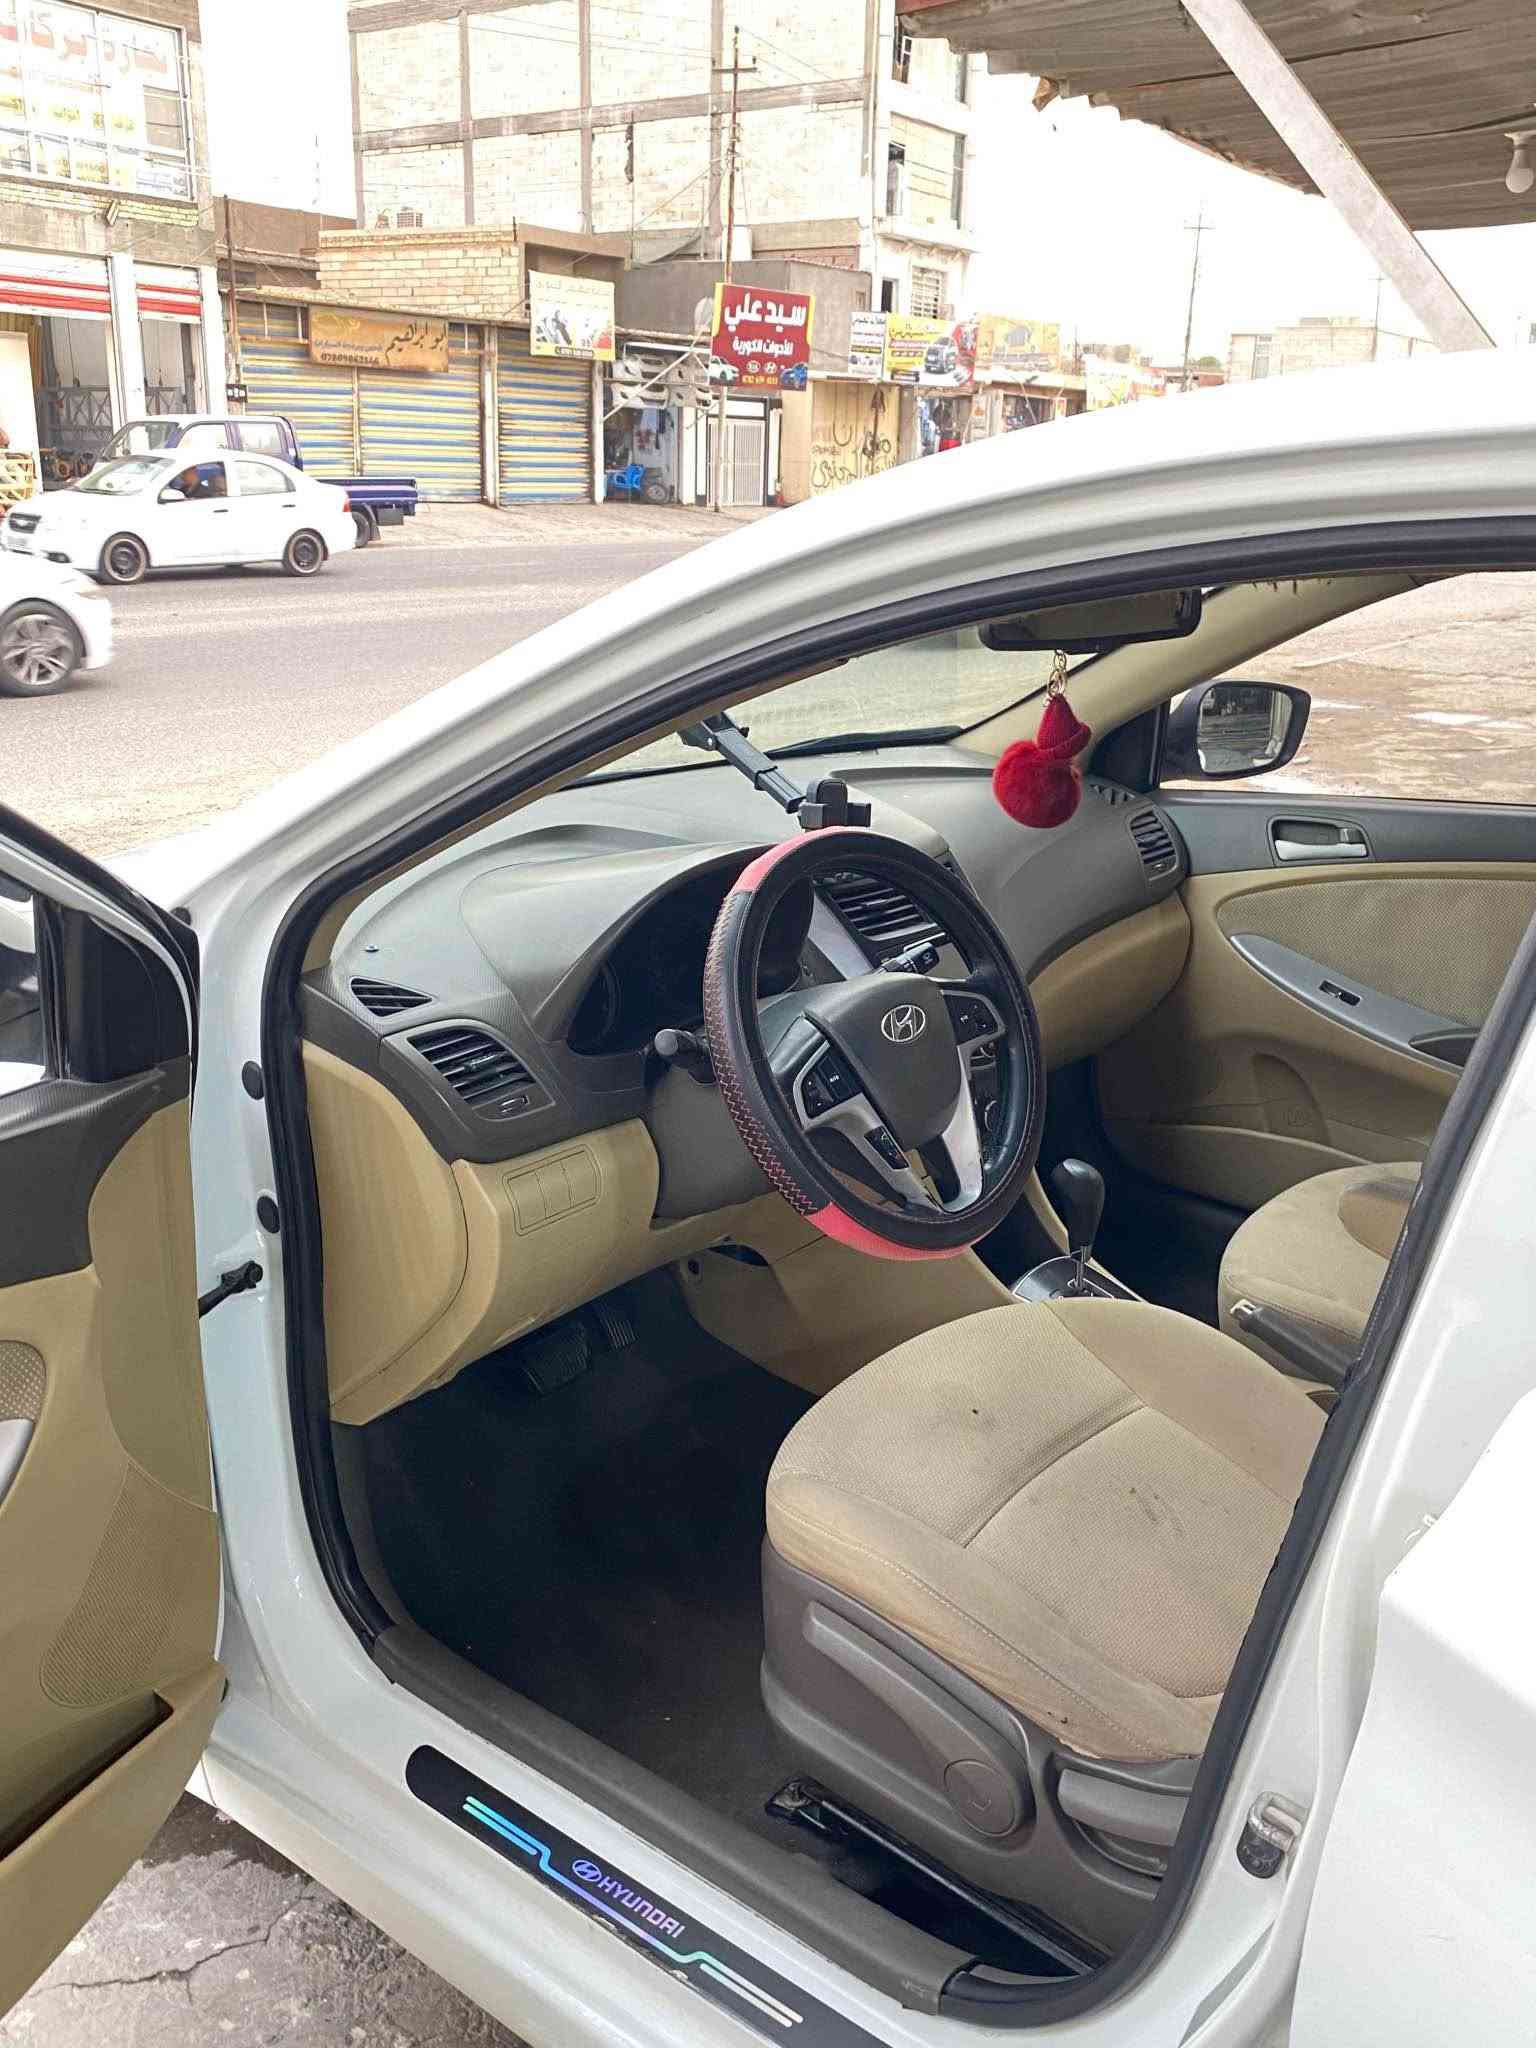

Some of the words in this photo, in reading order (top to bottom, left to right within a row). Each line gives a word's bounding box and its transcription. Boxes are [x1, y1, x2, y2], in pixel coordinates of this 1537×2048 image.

[723, 292, 764, 333] علي
[764, 299, 808, 333] سيد
[598, 1876, 686, 1938] HYUNDAI
